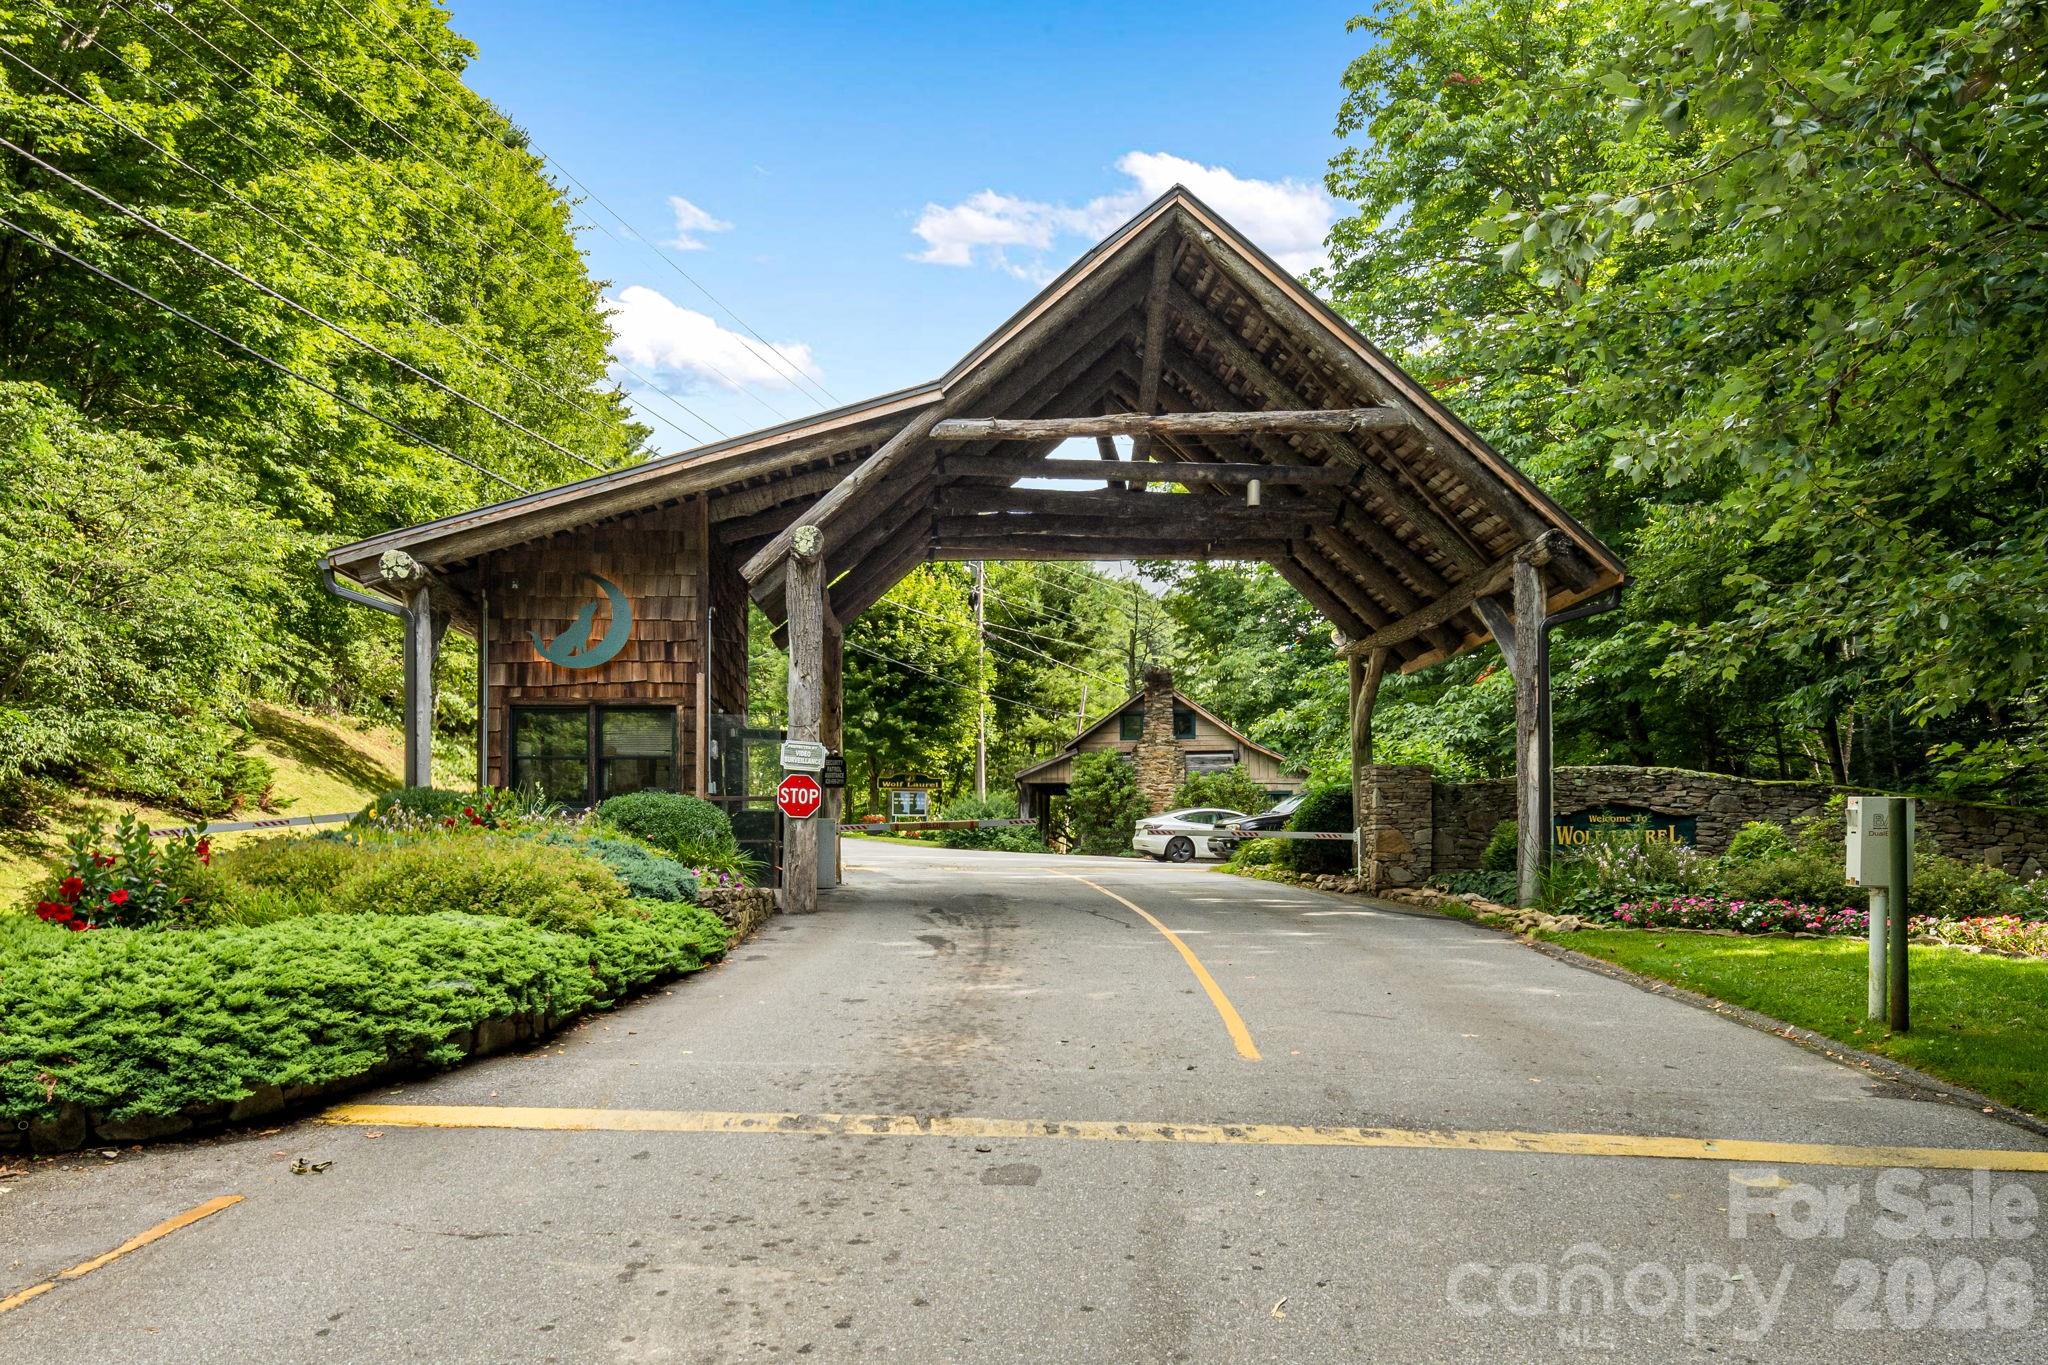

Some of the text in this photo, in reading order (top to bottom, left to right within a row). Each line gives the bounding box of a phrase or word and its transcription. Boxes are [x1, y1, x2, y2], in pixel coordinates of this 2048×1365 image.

[795, 750, 812, 758] VIDEO
[784, 755, 821, 765] SURVEILLANCE
[780, 788, 819, 804] STOP
[1588, 815, 1648, 823] Welcome To
